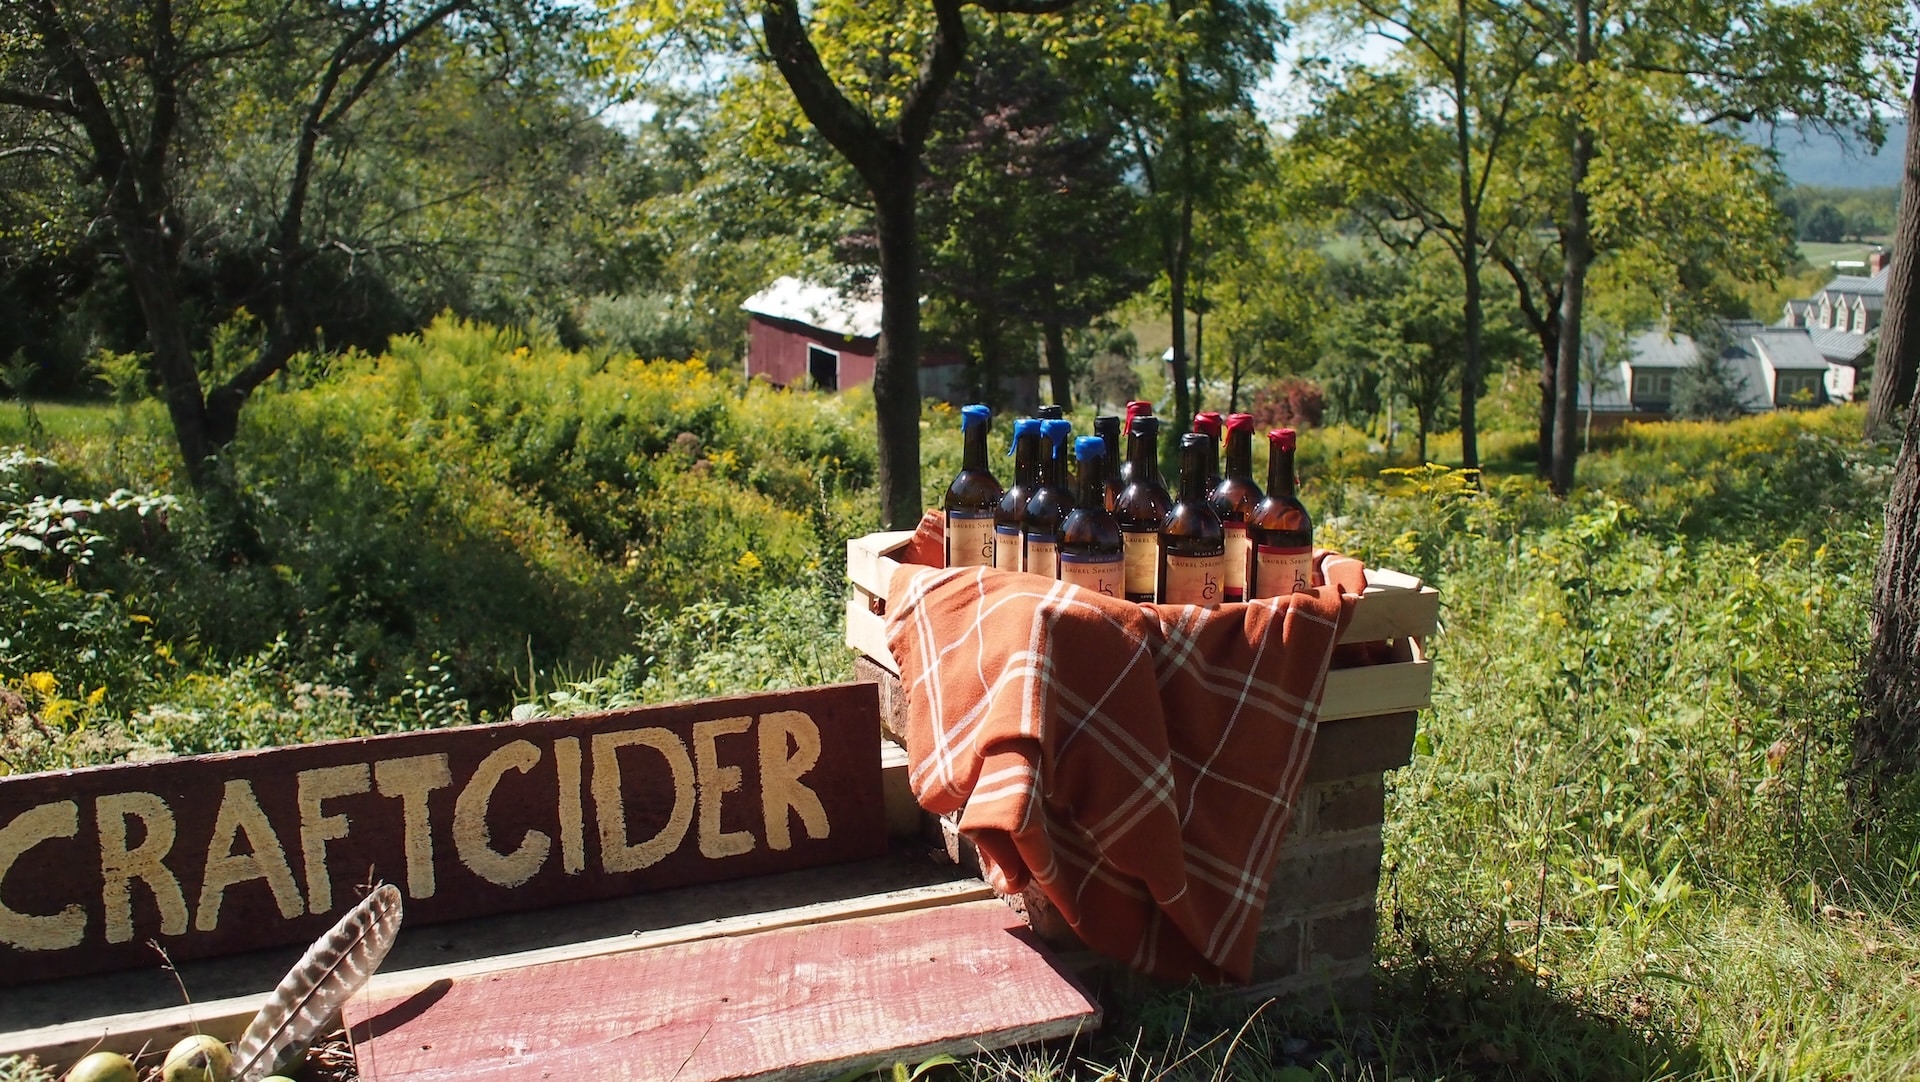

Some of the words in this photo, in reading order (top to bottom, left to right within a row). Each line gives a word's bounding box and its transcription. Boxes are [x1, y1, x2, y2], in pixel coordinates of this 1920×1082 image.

[953, 521, 976, 529] LAUREL
[1226, 530, 1245, 538] LAUR
[1031, 544, 1053, 553] LAURE
[1171, 560, 1198, 568] LAUREL
[1262, 556, 1288, 565] LAUREL
[1065, 564, 1090, 574] LAUREL
